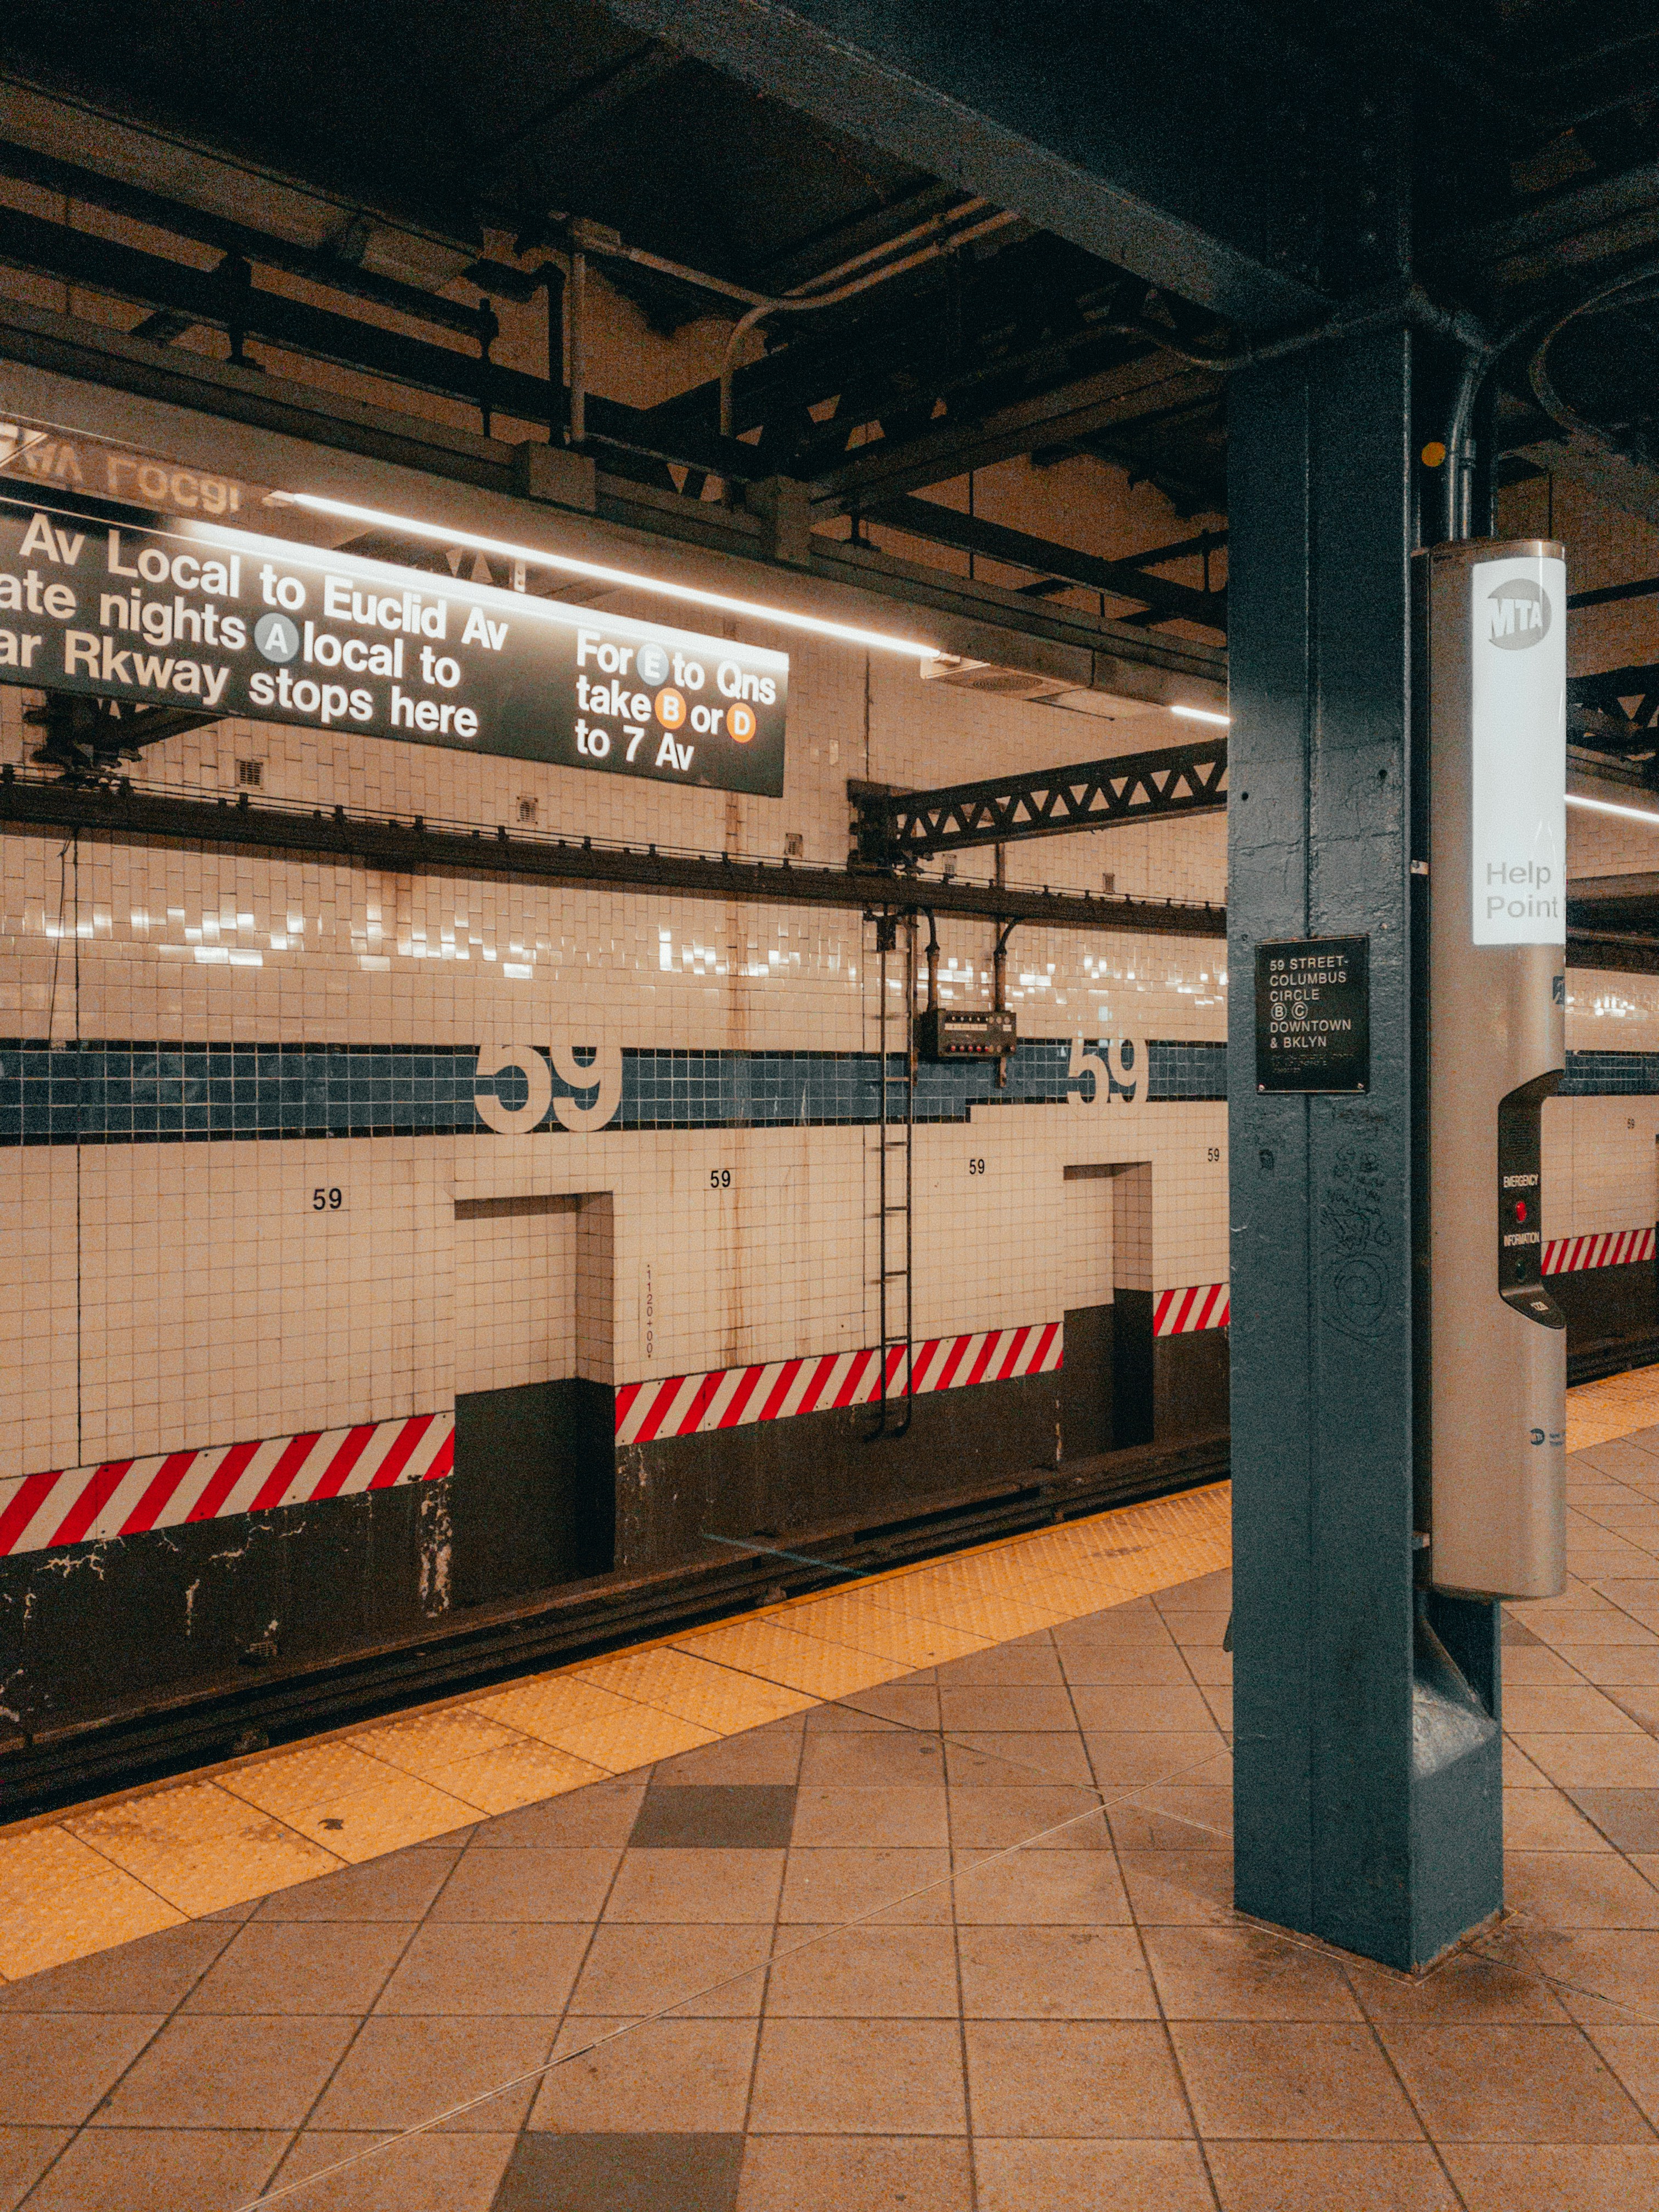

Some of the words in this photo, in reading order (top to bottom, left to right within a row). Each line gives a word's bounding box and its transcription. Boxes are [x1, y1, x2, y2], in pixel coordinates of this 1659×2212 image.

[19, 513, 84, 566] Av
[109, 529, 240, 599] Local
[259, 564, 306, 611] to
[324, 575, 447, 640] Euclid
[461, 607, 509, 651] Av
[1487, 597, 1542, 637] MTA
[99, 588, 246, 650] nights
[304, 620, 403, 679] local
[420, 646, 461, 689] to
[577, 629, 633, 675] For
[673, 652, 706, 691] to
[716, 660, 776, 705] Qns
[64, 629, 229, 706] Rkway
[249, 668, 374, 723] stops
[391, 686, 478, 738] here
[576, 675, 652, 721] take
[690, 704, 724, 735] or
[575, 719, 610, 758] to
[623, 726, 645, 762] 7
[655, 733, 694, 771] Av
[1487, 861, 1551, 890] Help
[1486, 894, 1558, 919] Point
[1269, 960, 1285, 971] 59
[1290, 956, 1348, 970] STREET-
[1269, 972, 1346, 986] COLUMBUS
[1269, 989, 1319, 1002] CIRCLE
[1270, 1020, 1352, 1033] DOWNTOWN
[1269, 1037, 1278, 1048] &
[1283, 1036, 1327, 1048] BKLYN
[1066, 1038, 1149, 1104] 59
[473, 1045, 623, 1134] 59
[969, 1158, 985, 1175] 59
[1208, 1148, 1220, 1162] 59
[710, 1170, 731, 1188] 59
[313, 1187, 343, 1210] 59
